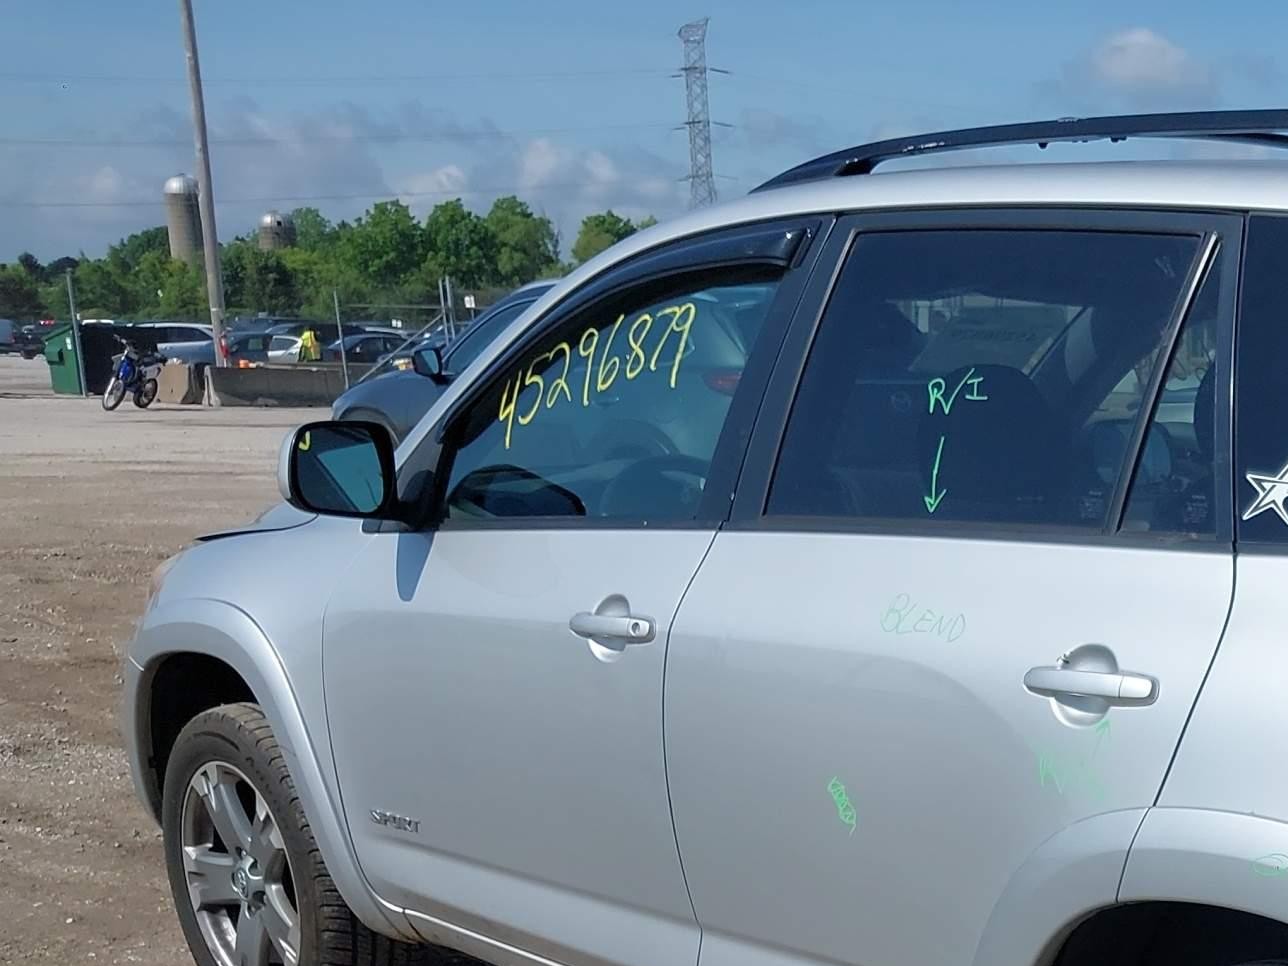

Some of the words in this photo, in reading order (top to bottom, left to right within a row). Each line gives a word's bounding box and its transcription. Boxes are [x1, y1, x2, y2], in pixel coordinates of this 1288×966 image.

[498, 302, 697, 449] 45296879
[928, 367, 988, 415] R/I
[880, 593, 966, 643] BLEND
[369, 809, 422, 833] SPORT
